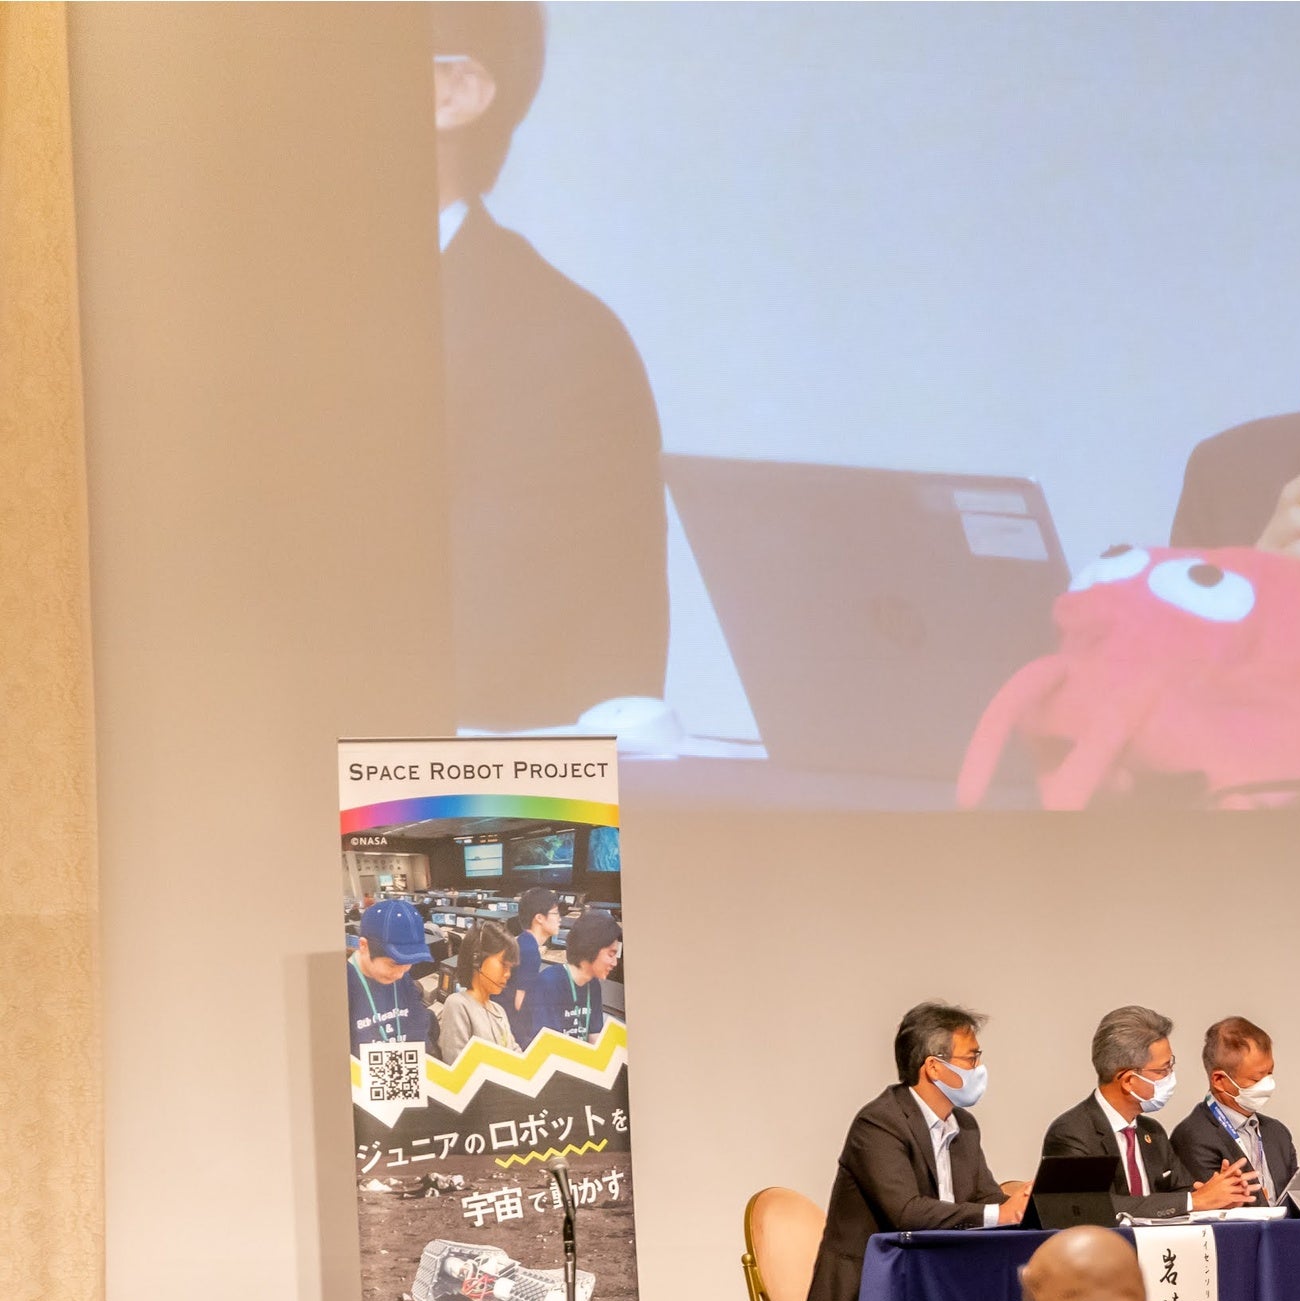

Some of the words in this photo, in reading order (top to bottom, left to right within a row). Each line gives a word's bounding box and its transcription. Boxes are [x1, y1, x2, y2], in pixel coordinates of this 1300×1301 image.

[349, 763, 420, 781] SPACE
[430, 762, 504, 780] ROBOT
[513, 761, 609, 779] PROJECT
[356, 1105, 629, 1174] ジュニアのロボットを
